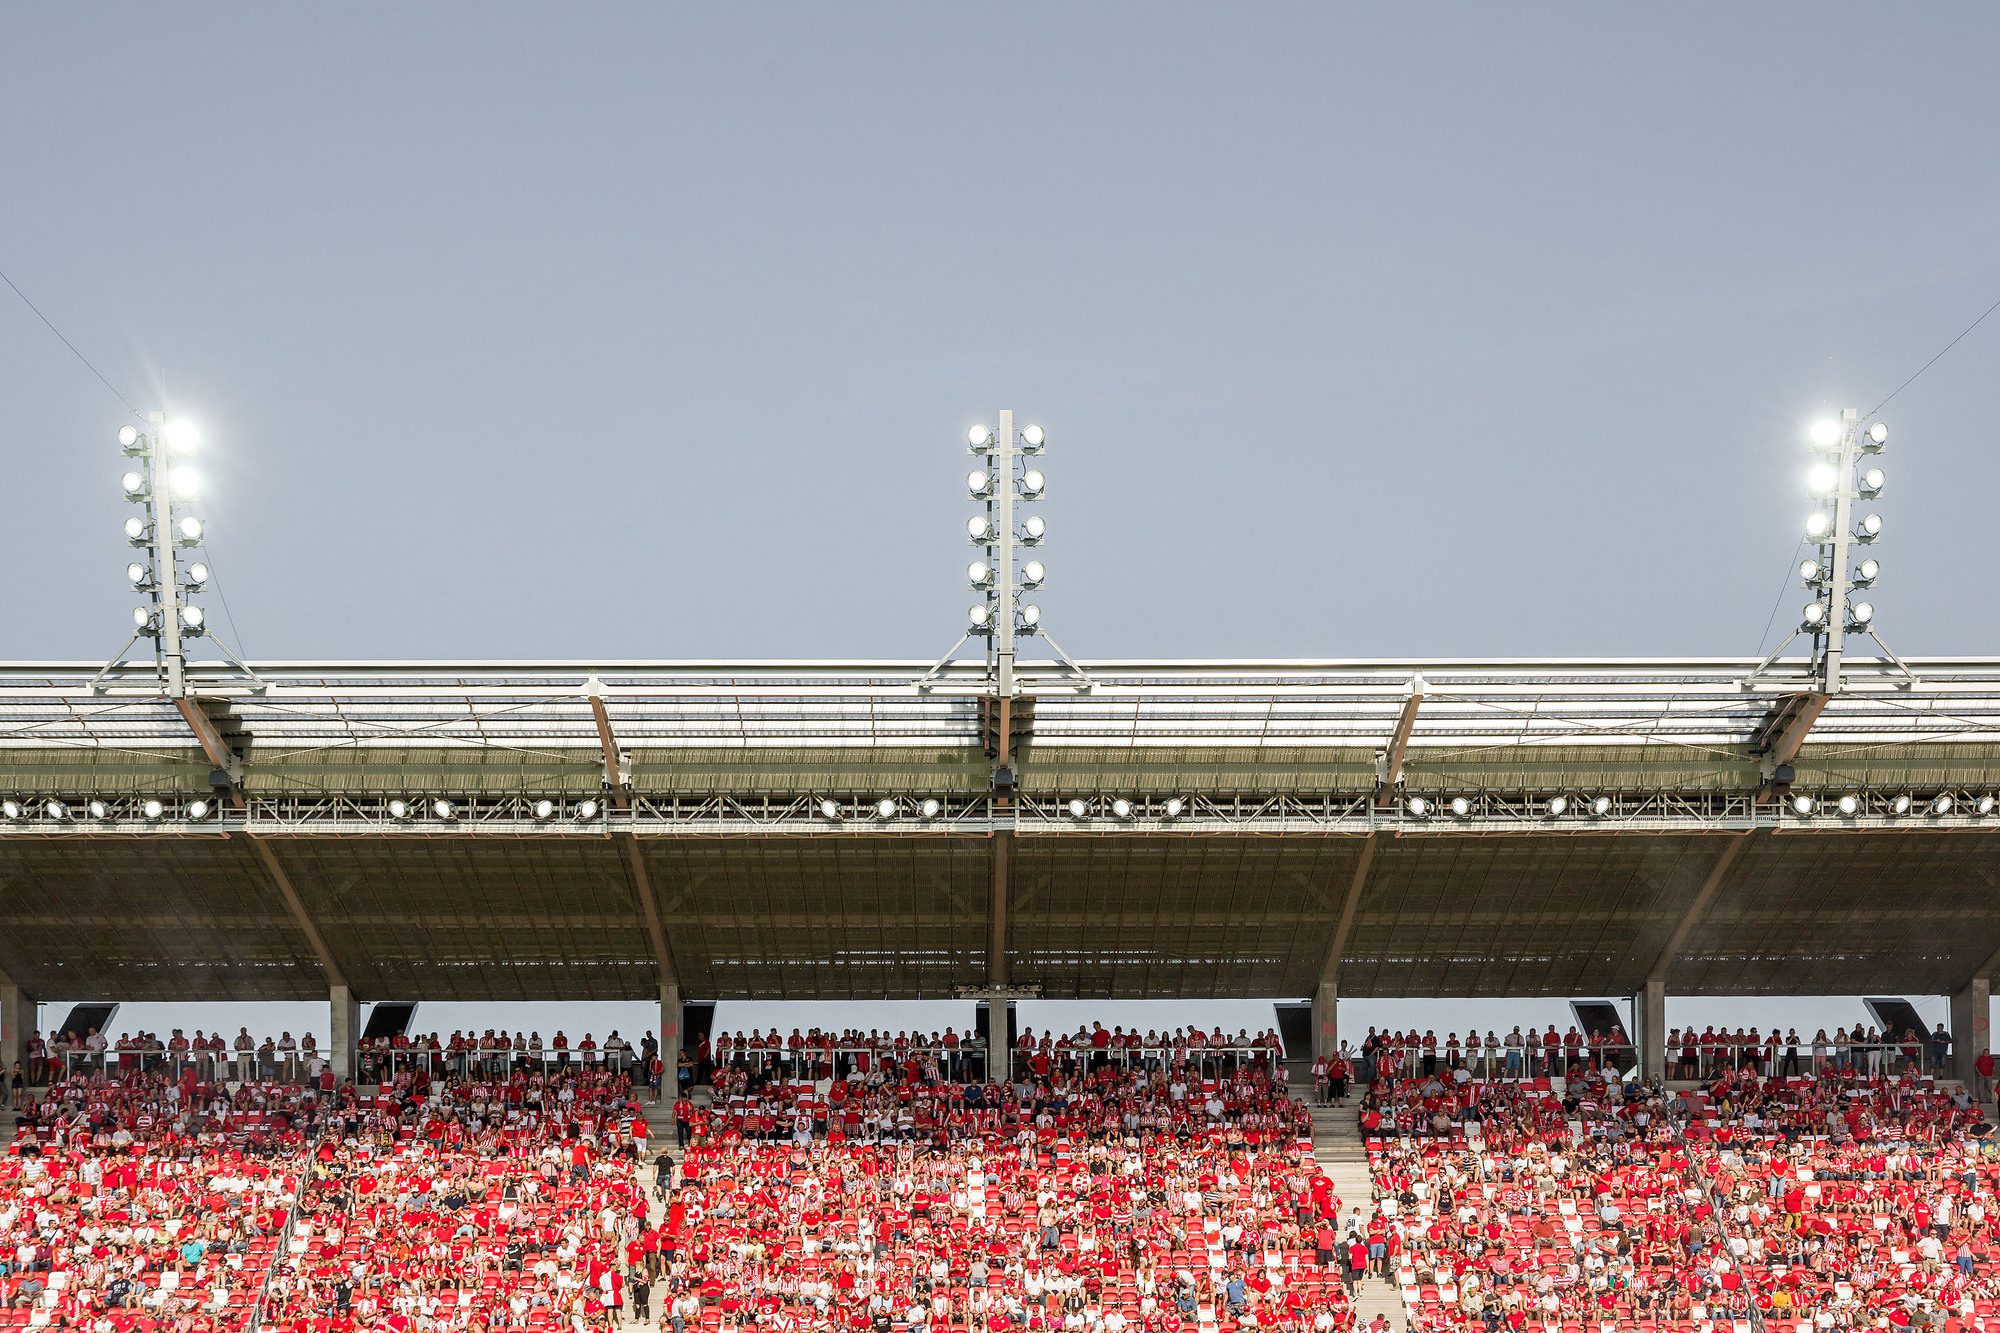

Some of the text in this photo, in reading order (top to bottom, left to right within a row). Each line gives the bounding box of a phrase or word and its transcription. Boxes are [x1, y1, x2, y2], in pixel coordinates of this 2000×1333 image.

[3, 1025, 14, 1039] L
[662, 1023, 677, 1038] M
[1322, 1023, 1335, 1039] N
[1347, 1218, 1356, 1228] 50
